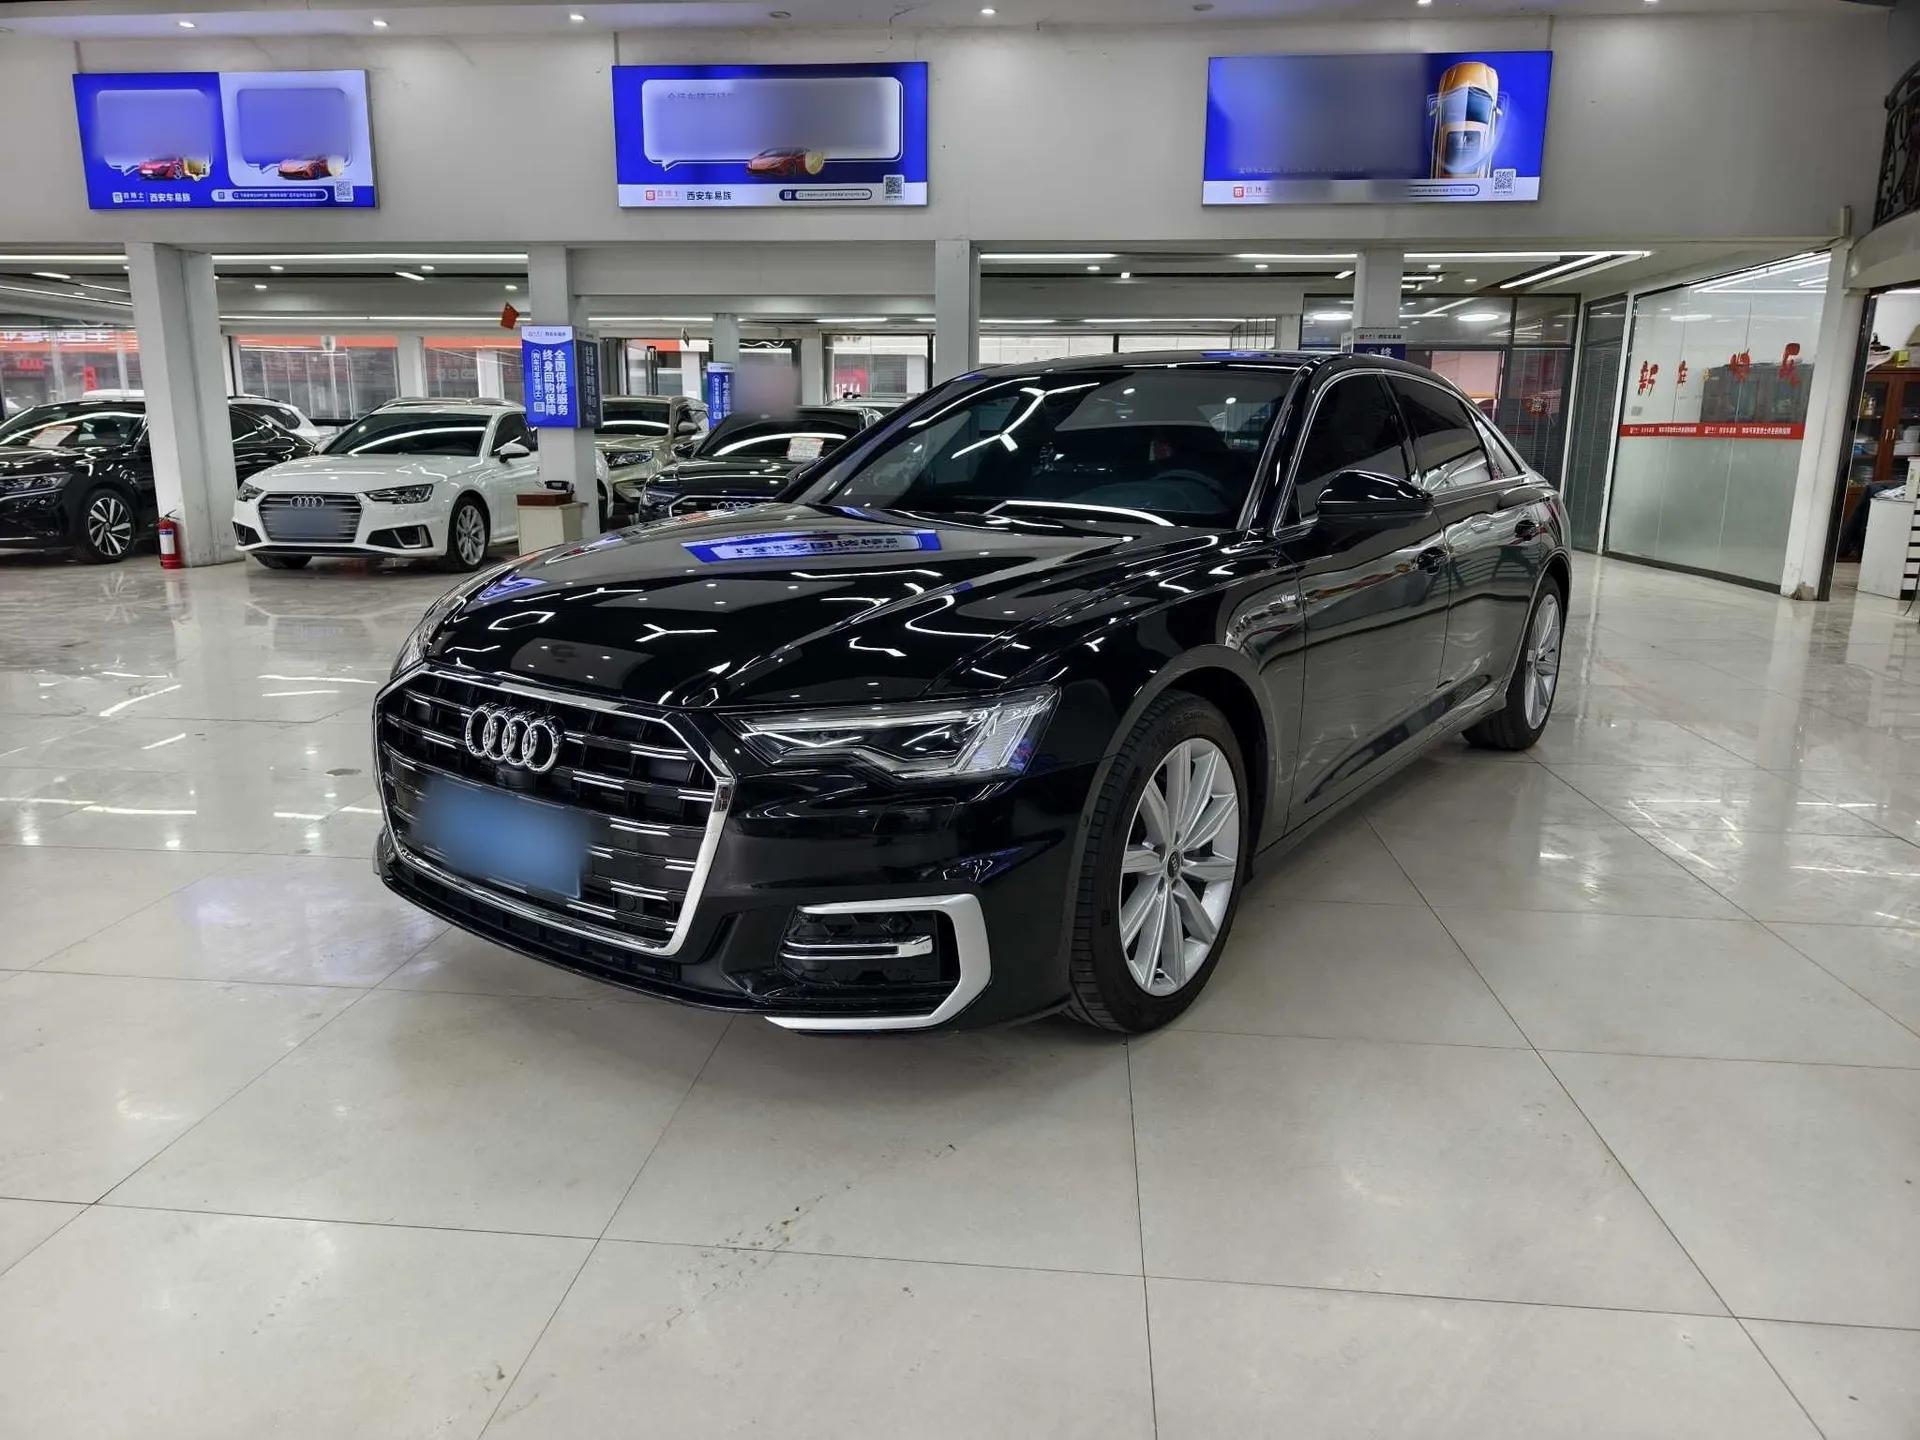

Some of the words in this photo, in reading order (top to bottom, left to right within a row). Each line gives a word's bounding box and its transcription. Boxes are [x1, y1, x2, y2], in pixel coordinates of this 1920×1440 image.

[687, 191, 732, 201] 西安车易族
[542, 349, 557, 416] 终身回购保障
[554, 350, 568, 416] 全国保修服务
